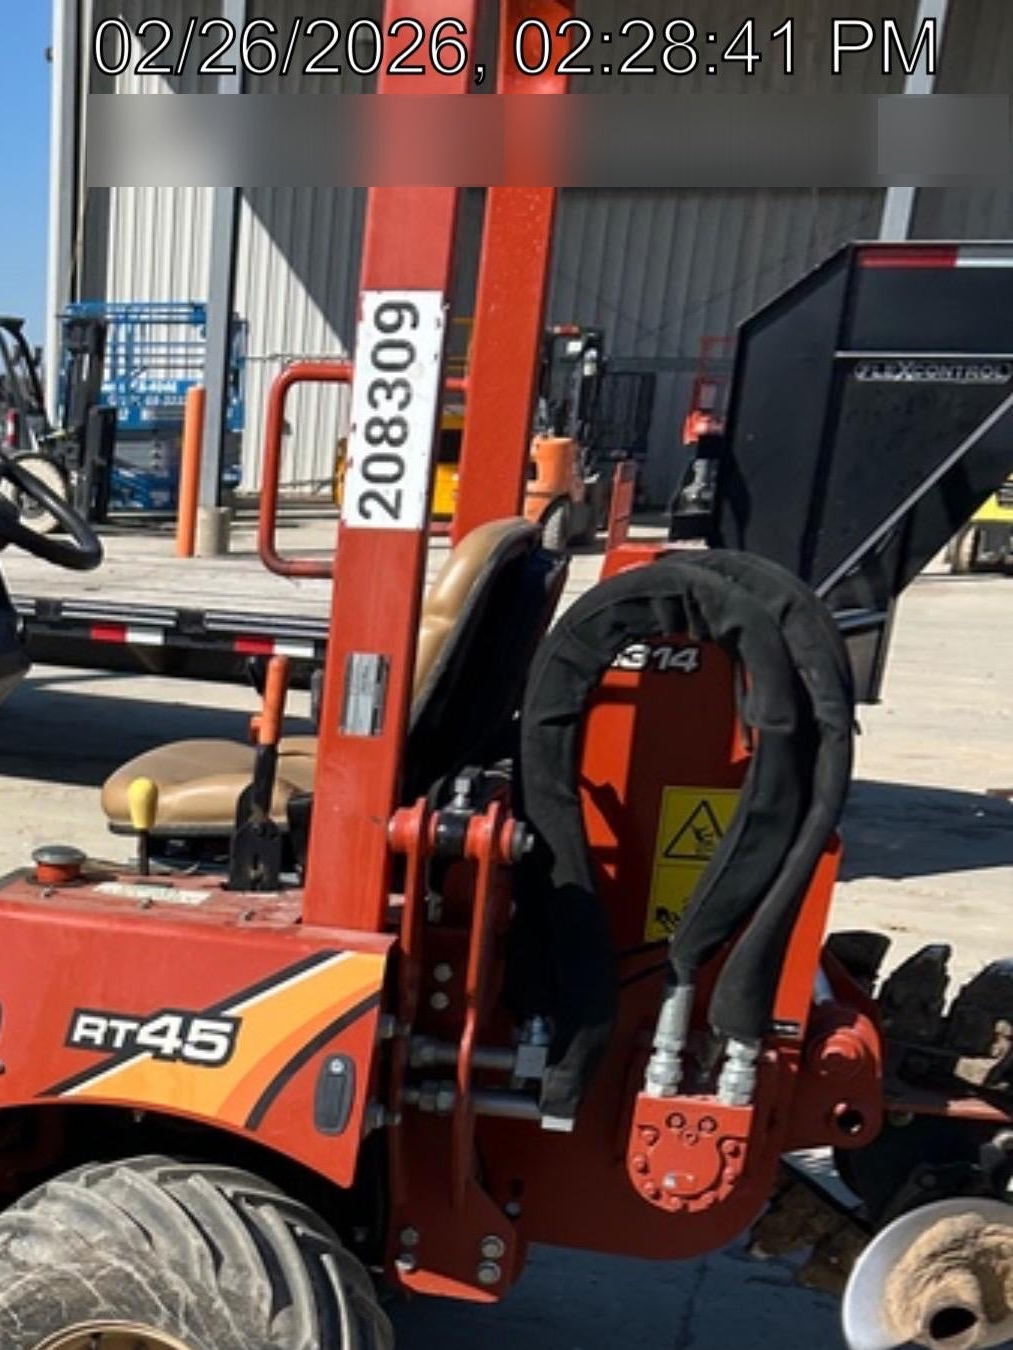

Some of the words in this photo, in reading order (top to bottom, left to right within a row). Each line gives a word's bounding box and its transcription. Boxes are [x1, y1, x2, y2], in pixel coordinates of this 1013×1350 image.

[357, 300, 420, 520] 208309
[611, 643, 699, 673] 314
[72, 1013, 234, 1062] RT45
